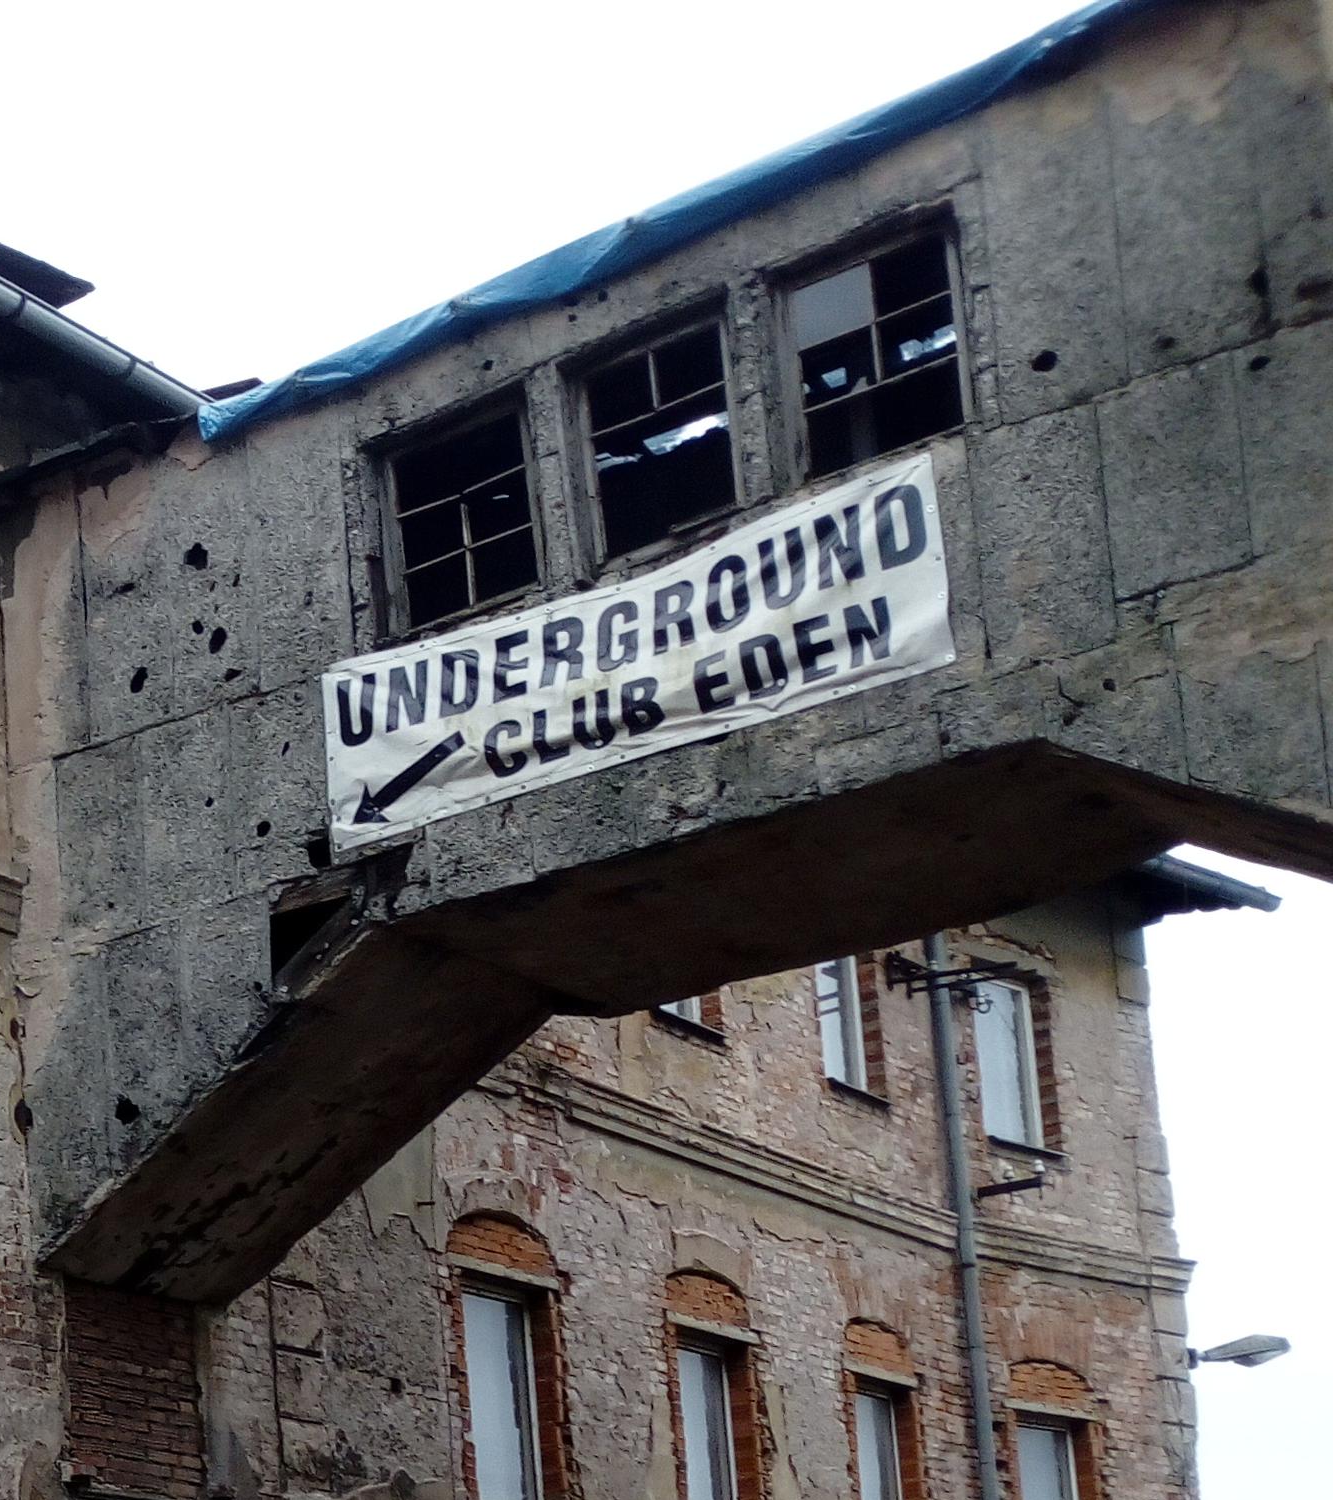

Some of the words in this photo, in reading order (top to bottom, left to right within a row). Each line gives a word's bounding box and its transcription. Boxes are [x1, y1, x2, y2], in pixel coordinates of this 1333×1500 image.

[336, 484, 928, 747] UNDERGROUND
[484, 675, 665, 779] CLUB
[694, 597, 891, 713] EDEN
